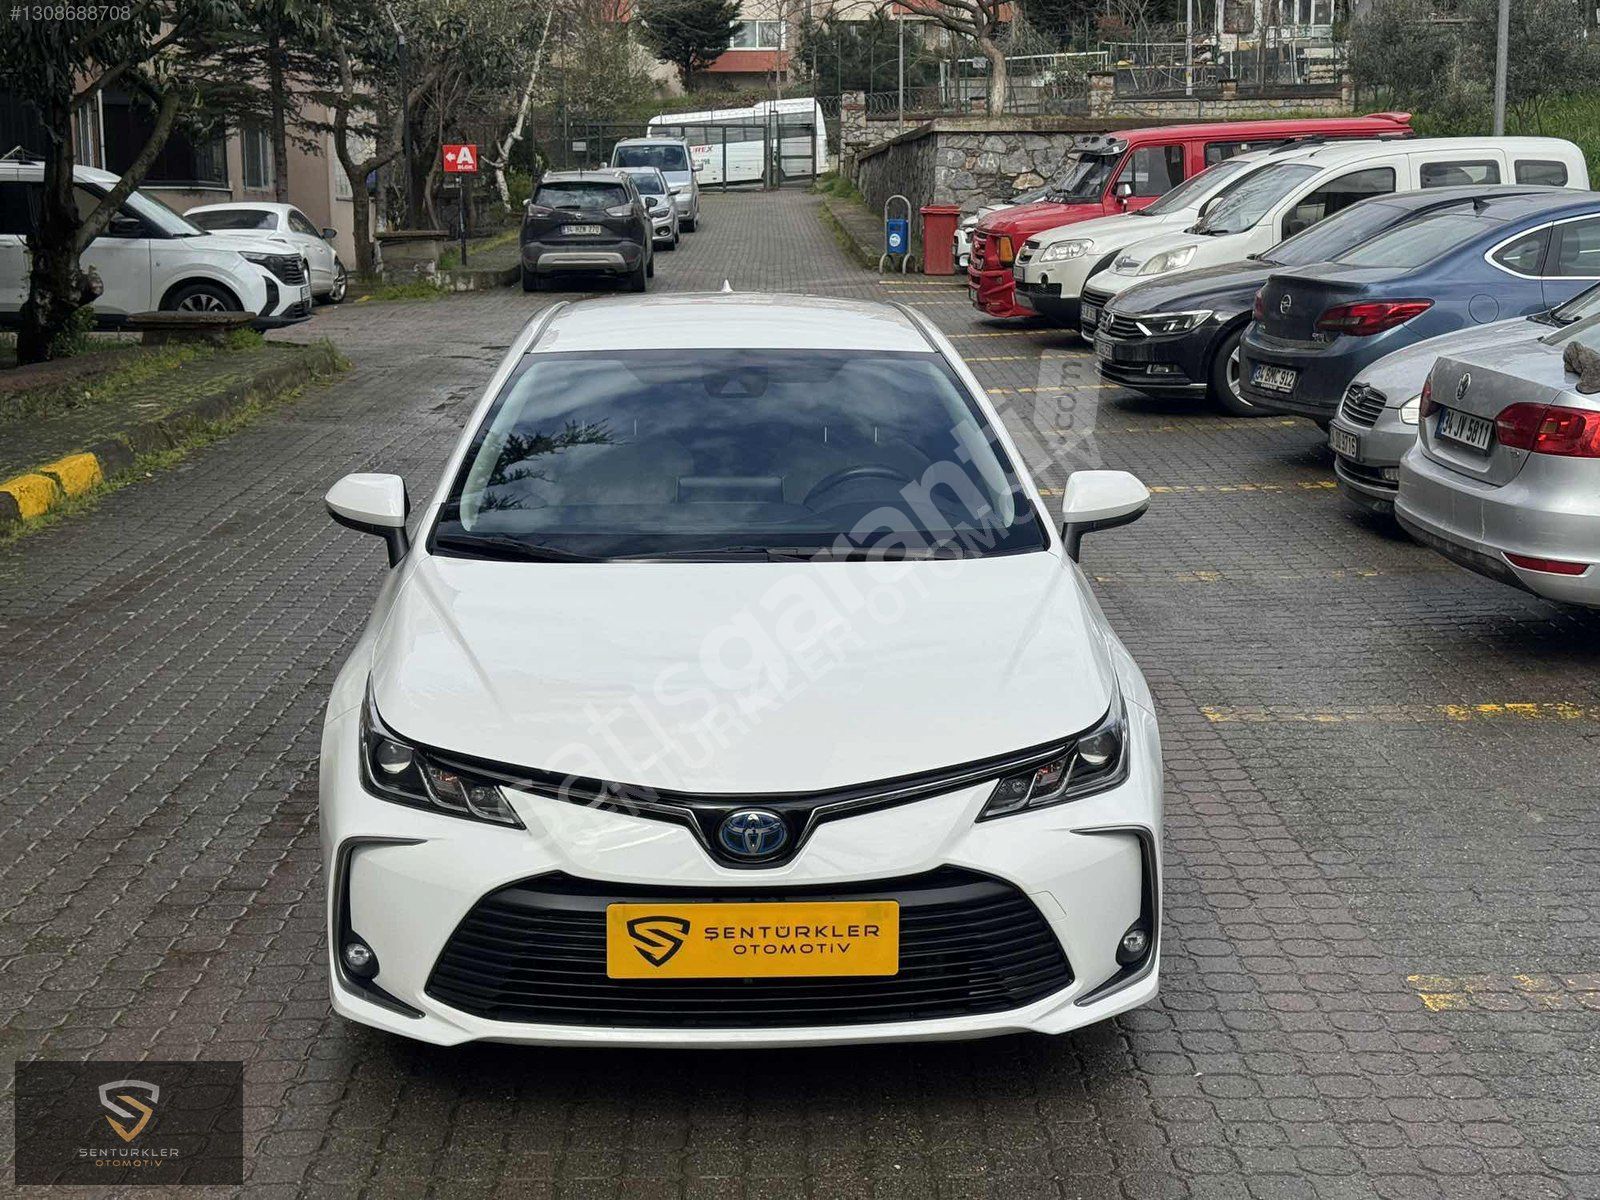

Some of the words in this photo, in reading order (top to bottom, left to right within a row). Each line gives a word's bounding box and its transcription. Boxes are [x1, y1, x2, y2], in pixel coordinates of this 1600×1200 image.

[456, 146, 474, 164] A
[1254, 365, 1265, 382] 34
[1279, 370, 1295, 388] 912
[1443, 408, 1455, 434] 34
[1466, 418, 1490, 447] 5811
[704, 924, 880, 941] ŞENTÜRKLER
